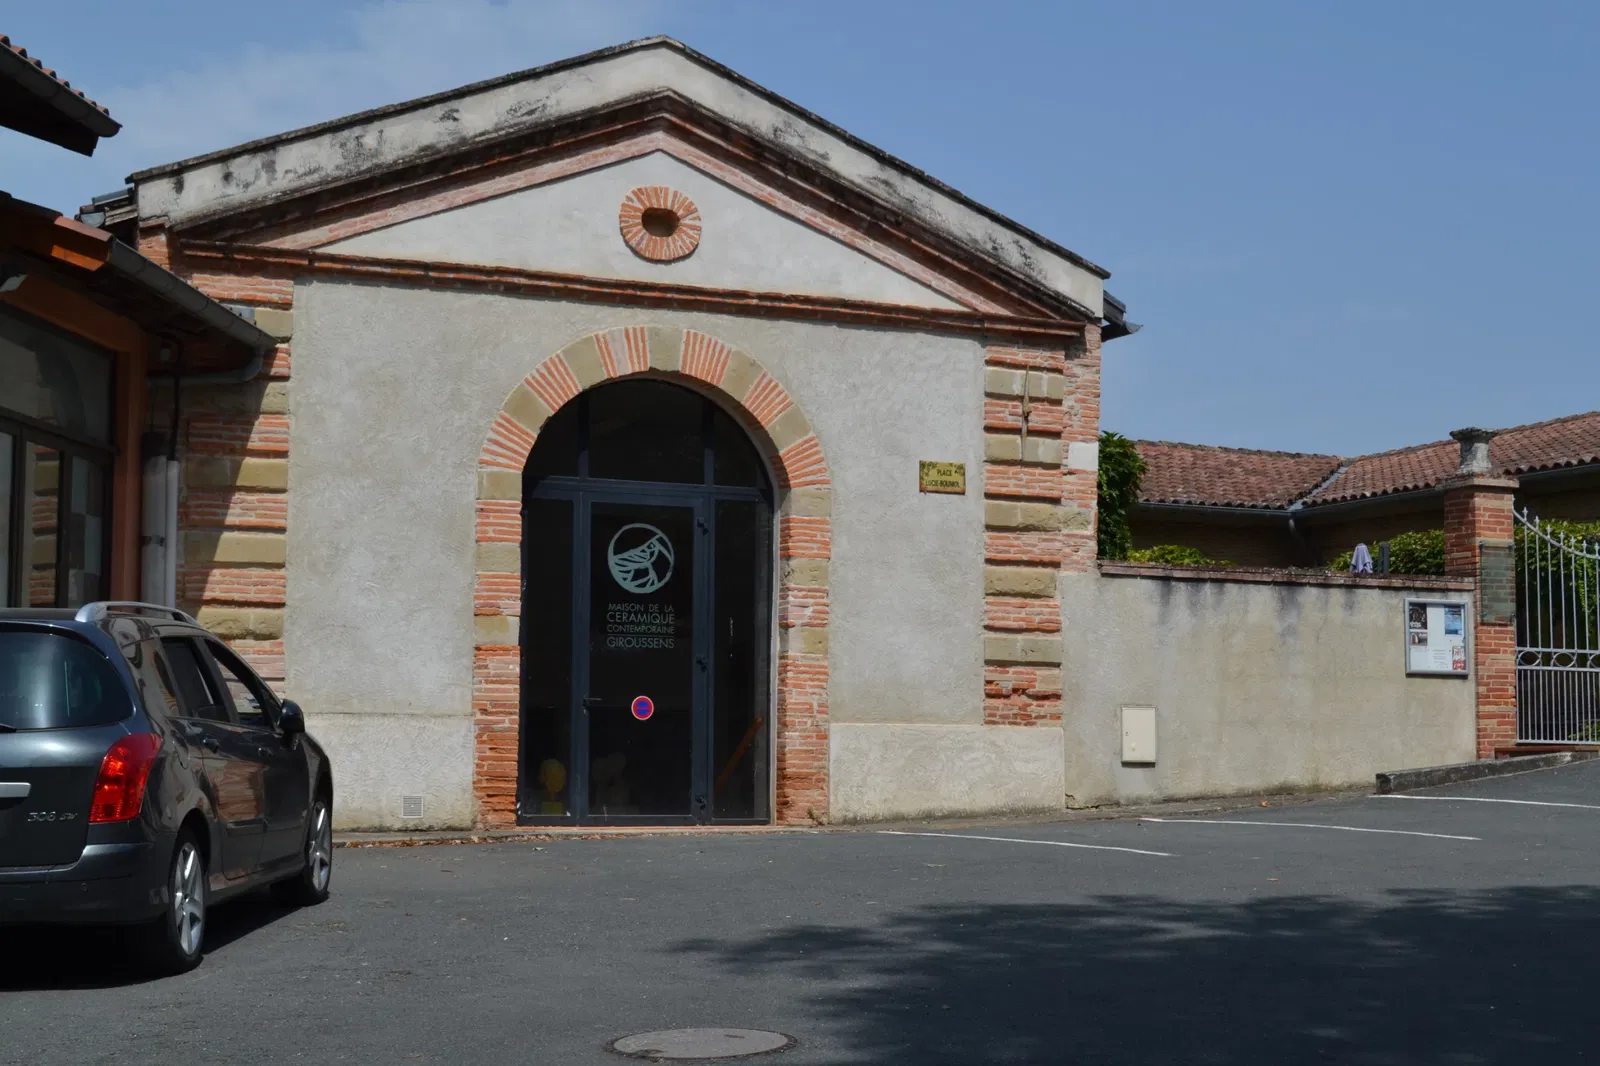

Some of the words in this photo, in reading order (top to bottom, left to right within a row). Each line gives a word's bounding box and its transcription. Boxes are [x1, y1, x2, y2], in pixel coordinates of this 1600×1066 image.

[937, 469, 952, 477] PLACE
[608, 603, 644, 612] MAISON
[648, 603, 660, 612] DE
[664, 604, 675, 613] LA
[606, 611, 676, 624] CERAMIQUE
[606, 624, 675, 634] CONTEMPORAINE
[606, 636, 675, 649] GIROUSSENS
